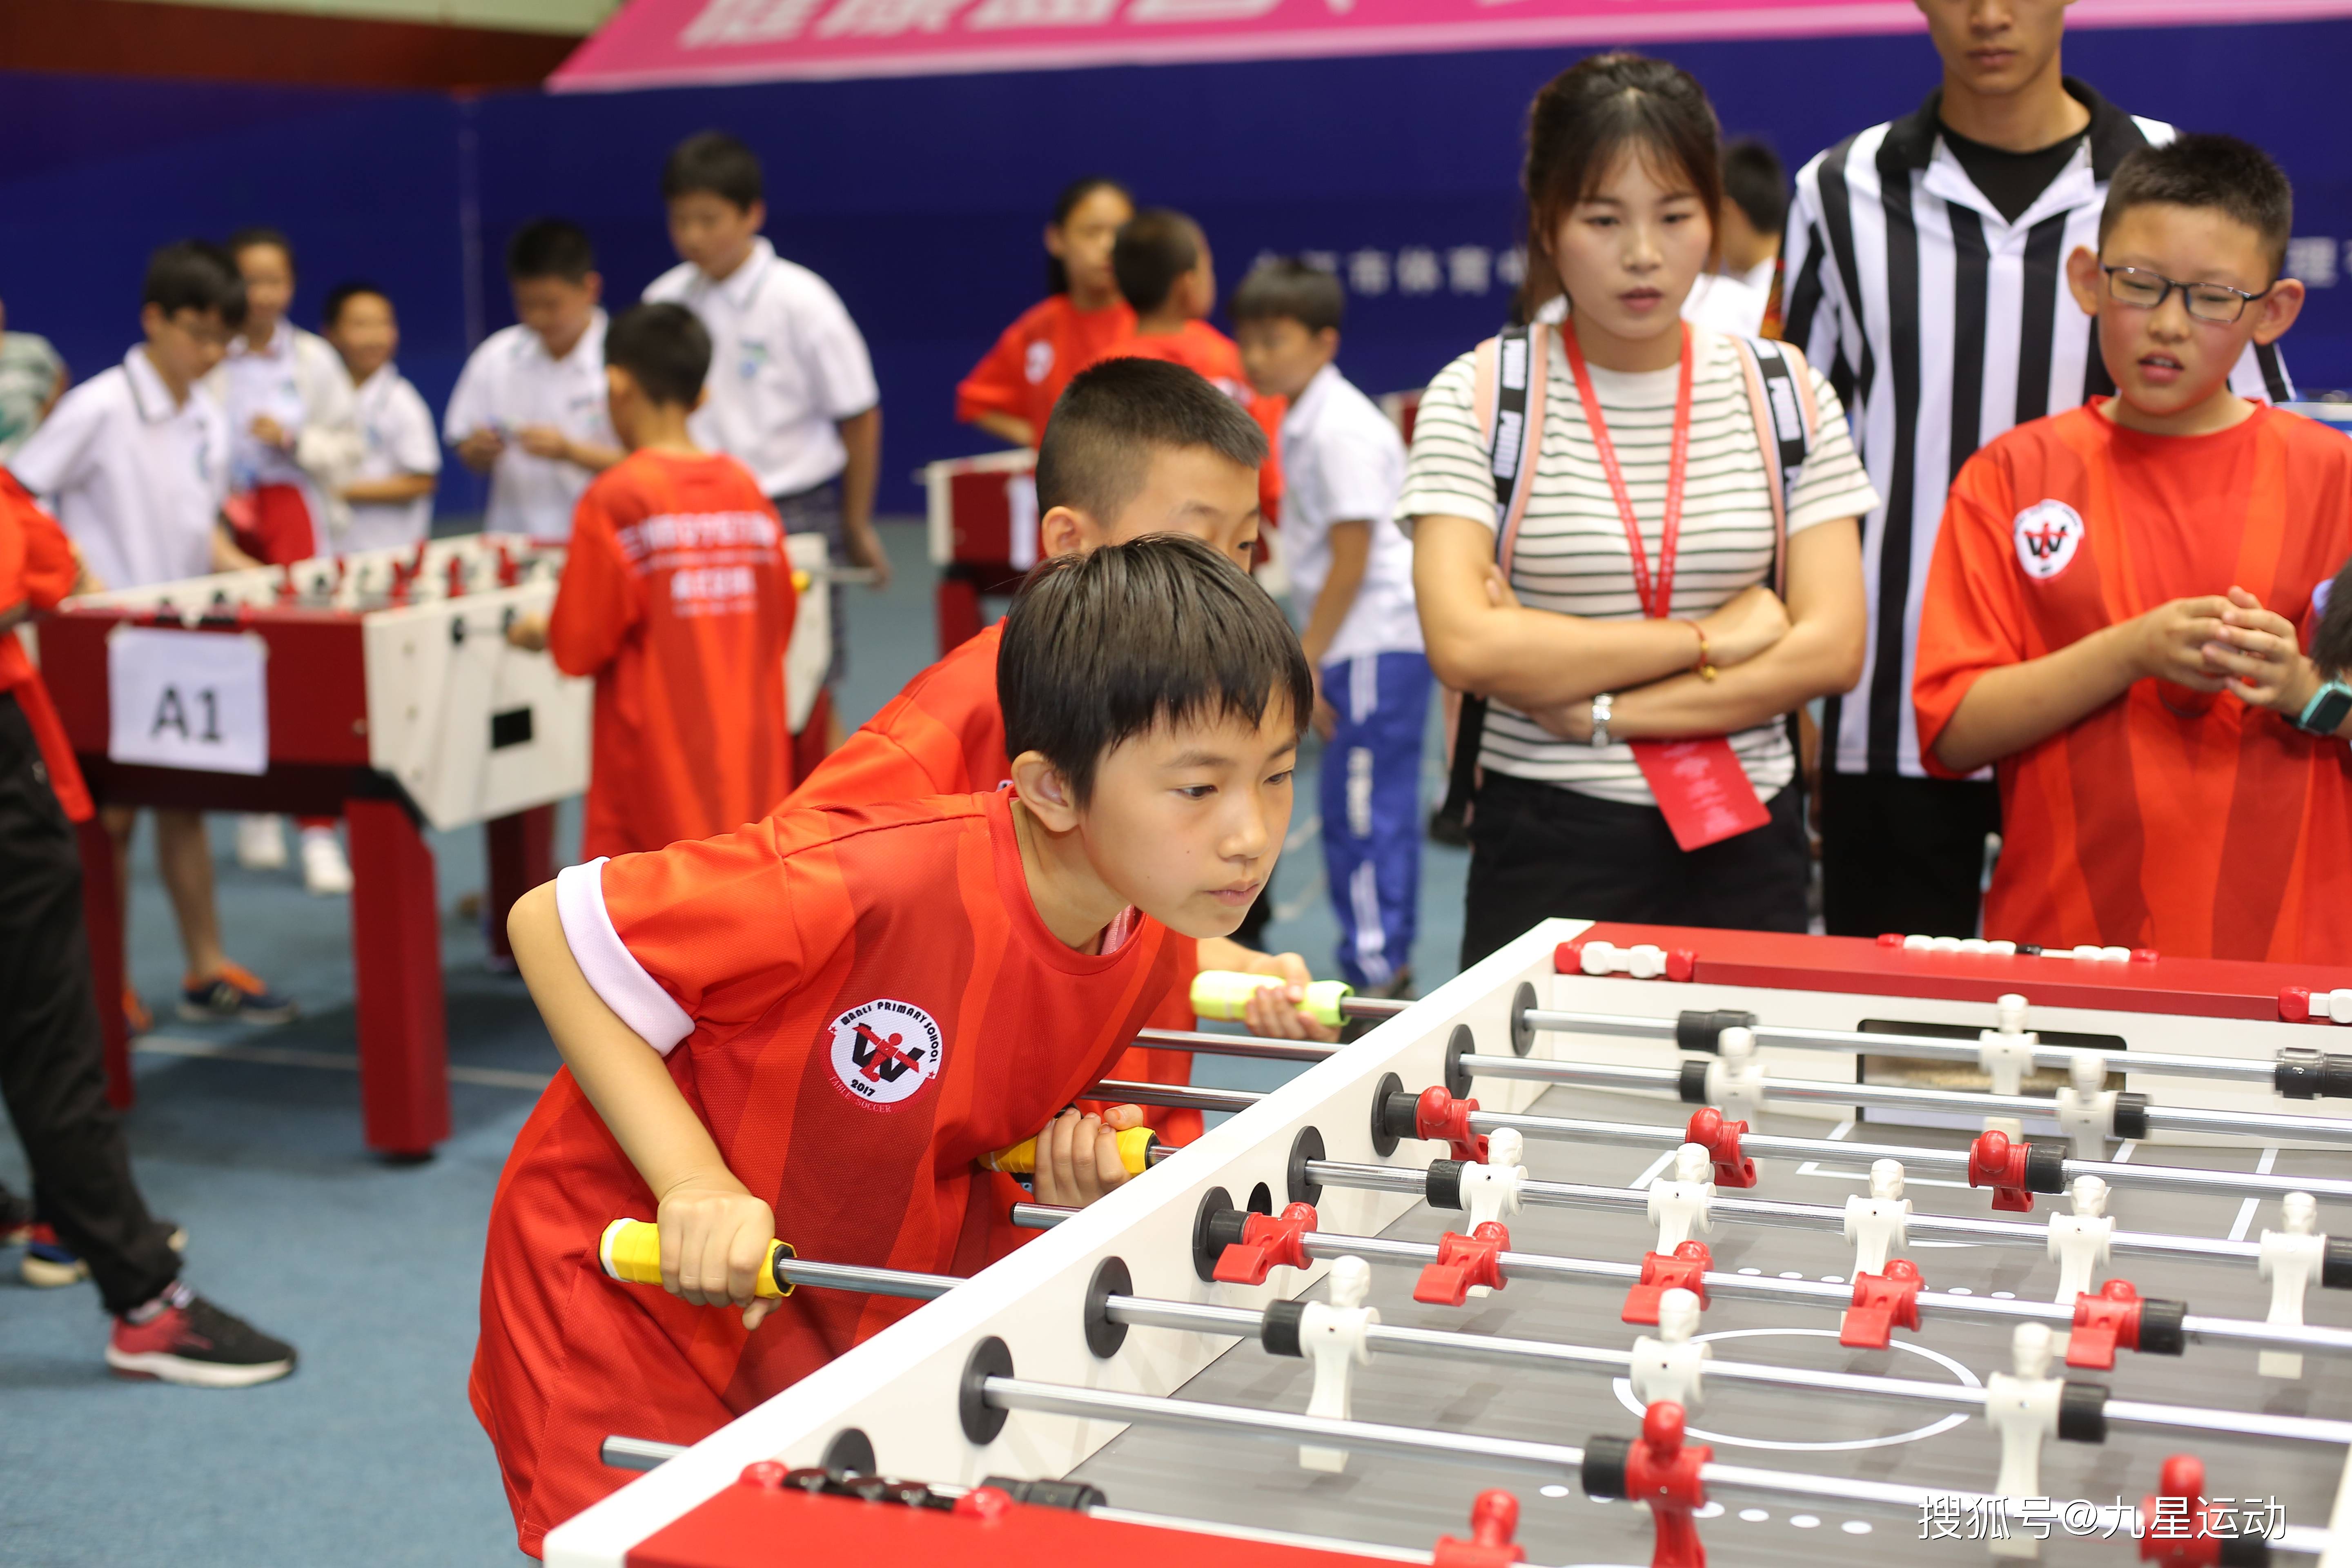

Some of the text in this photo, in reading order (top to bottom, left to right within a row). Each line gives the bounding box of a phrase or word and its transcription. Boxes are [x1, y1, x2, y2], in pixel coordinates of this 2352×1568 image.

[149, 683, 225, 743] A1
[878, 1001, 928, 1023] PRIMARY
[829, 1076, 892, 1112] TABLE SOCCER
[851, 1079, 876, 1097] 2017
